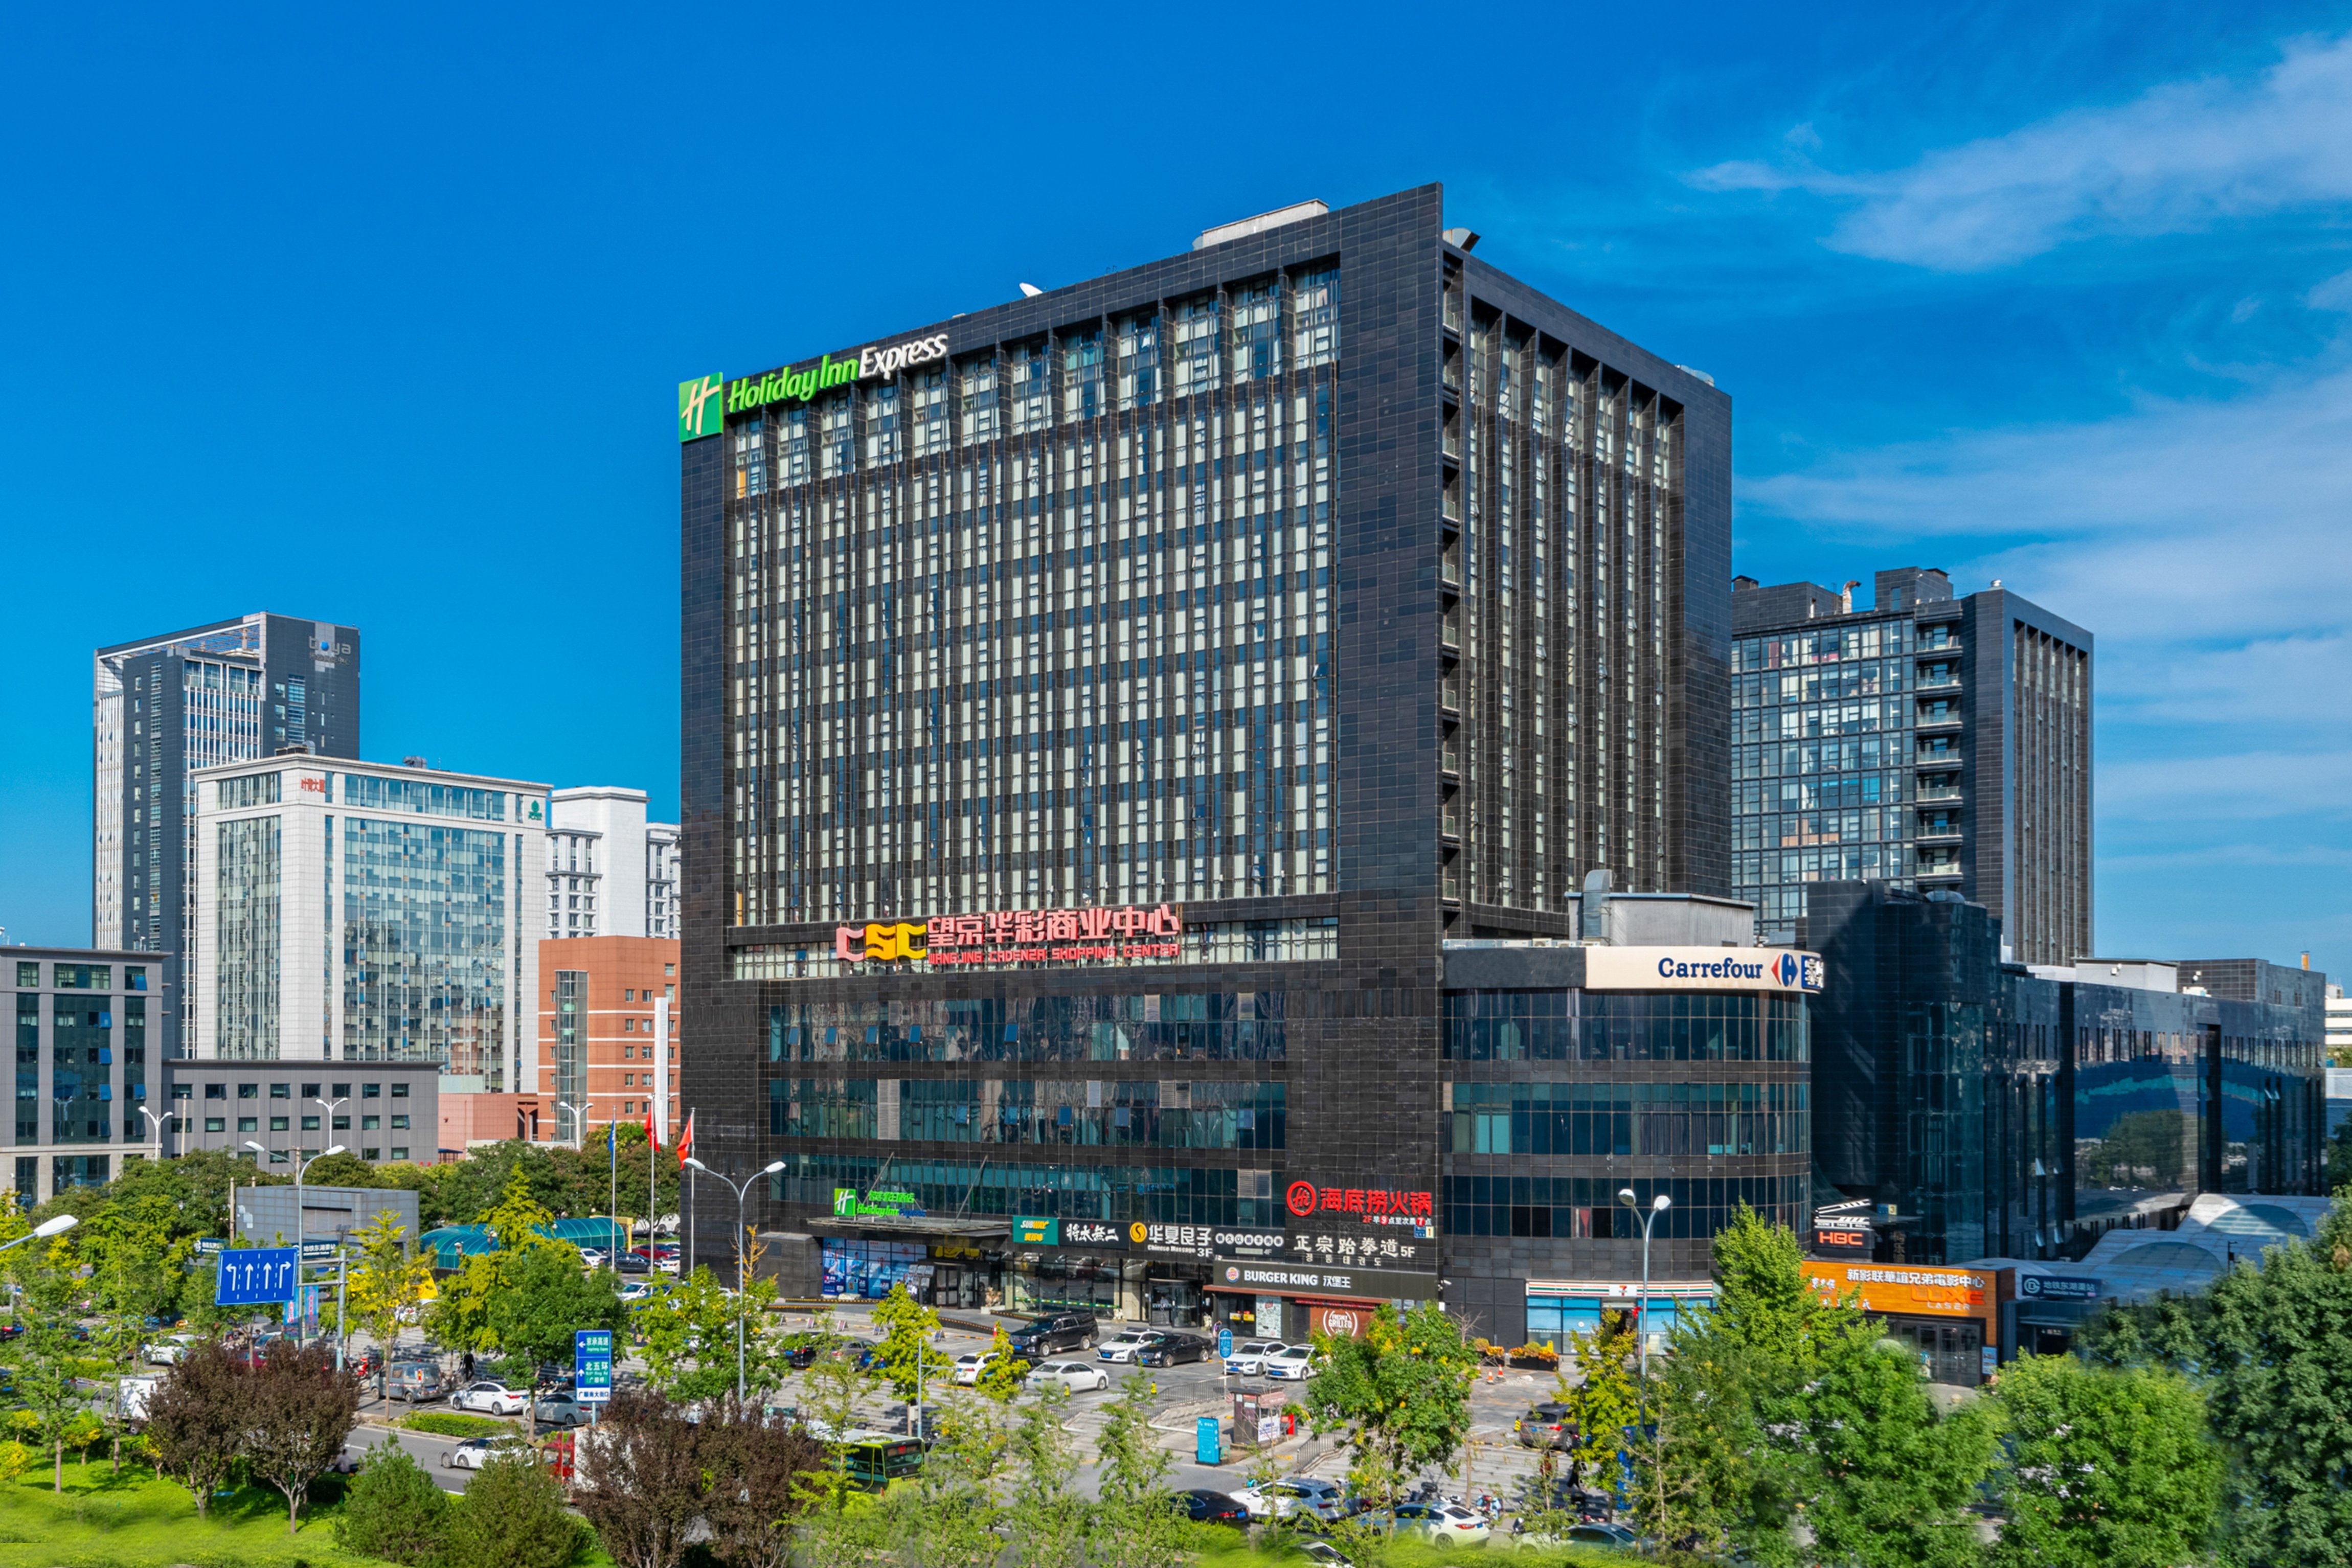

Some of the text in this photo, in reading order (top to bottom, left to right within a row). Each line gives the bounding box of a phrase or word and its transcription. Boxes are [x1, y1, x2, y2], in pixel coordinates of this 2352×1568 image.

[727, 334, 948, 413] Holiday Inn Express
[928, 903, 1180, 947] 望京华彩商业中心
[928, 943, 1180, 965] WANGJING CADENZA SHOPPING CENTER
[1658, 957, 1763, 979] Carrefour
[1320, 1187, 1432, 1216] 海底捞火锅
[857, 1202, 885, 1217] Holiday
[886, 1205, 899, 1216] Inn
[1890, 1206, 1895, 1214] 3
[1020, 1220, 1049, 1230] SUBWAY
[1362, 1215, 1372, 1223] 2F
[1149, 1224, 1212, 1246] 华夏良子
[1819, 1231, 1863, 1246] HBC
[1197, 1247, 1213, 1257] 3F
[1294, 1235, 1415, 1258] 正宗跆拳道 5F
[1243, 1269, 1351, 1288] BURGER KING 汉堡王
[2043, 1281, 2095, 1292] 地铁东湖渠站
[1911, 1285, 1985, 1305] LUXE
[1927, 1301, 1971, 1310] LASER
[1328, 1319, 1352, 1328] GRILLED
[586, 1337, 608, 1346] 京承高速
[585, 1361, 608, 1371] 北五环
